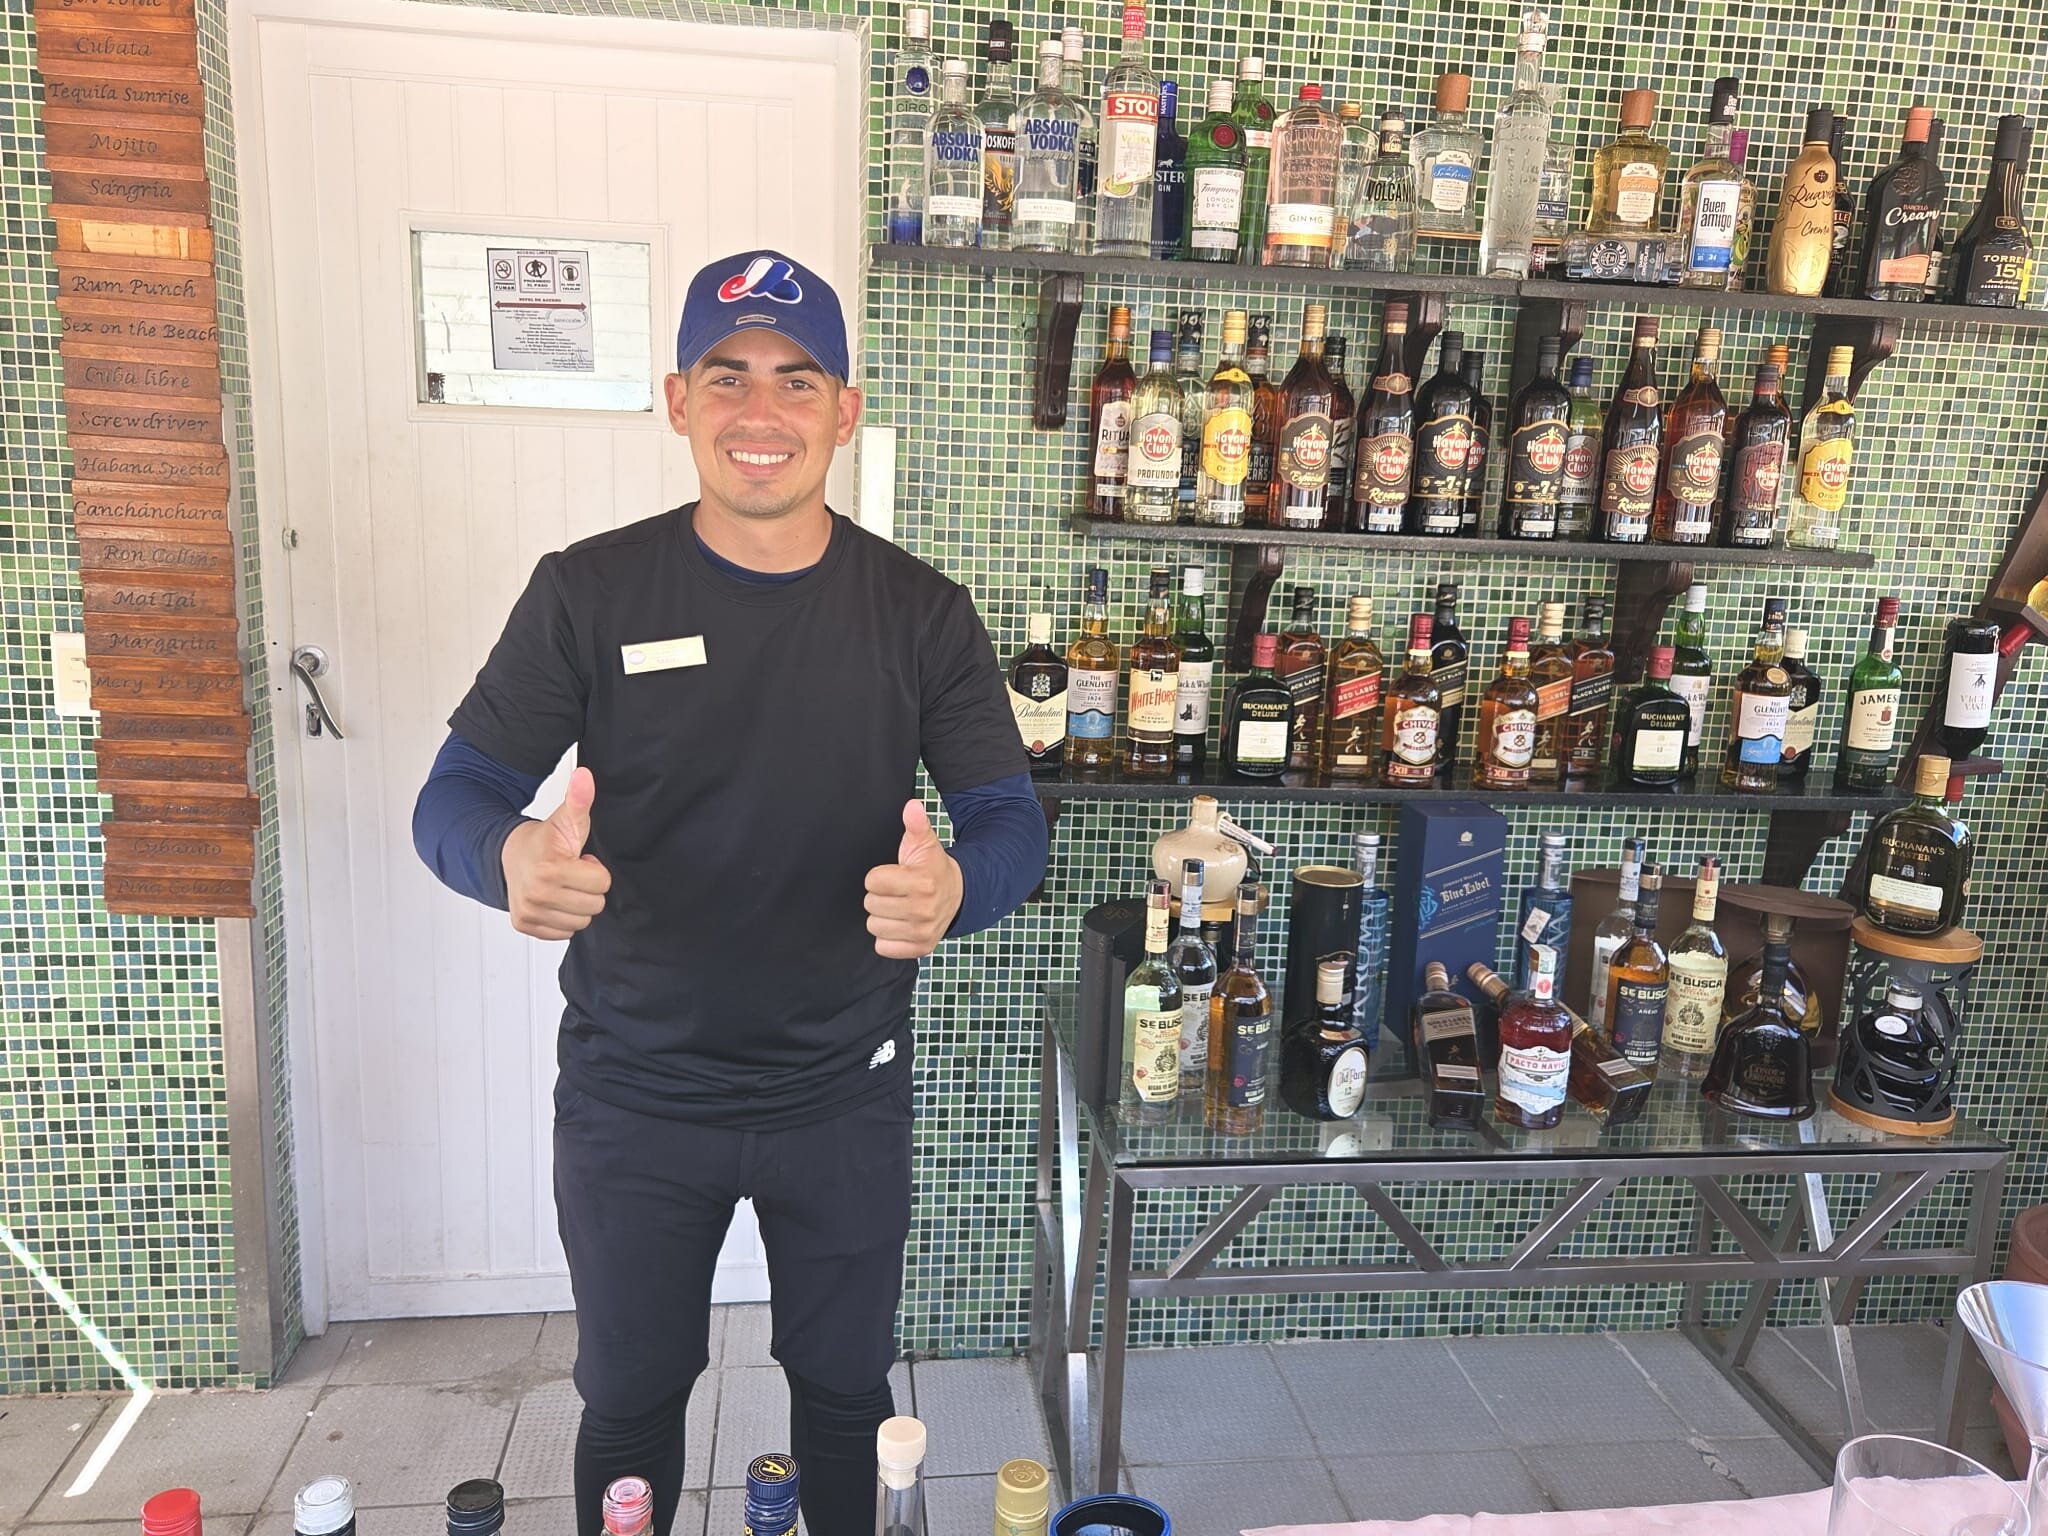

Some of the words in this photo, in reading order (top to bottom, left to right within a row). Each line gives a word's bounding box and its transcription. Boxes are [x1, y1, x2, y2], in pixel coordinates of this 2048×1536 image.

[76, 36, 153, 56] Cubata
[49, 83, 118, 105] Tequila
[125, 87, 190, 106] Sunrise
[1025, 119, 1079, 138] ABSOLUT
[89, 133, 158, 157] Mojito
[932, 132, 983, 148] ABSOLUT
[985, 134, 1016, 150] OSKOFF
[1030, 134, 1075, 152] VODKA
[937, 146, 979, 163] VODKA
[1155, 170, 1186, 184] STER
[1702, 197, 1726, 213] Buen
[1289, 214, 1308, 223] GIN
[1309, 215, 1324, 224] MG
[1700, 212, 1732, 233] amigo
[1885, 206, 1941, 227] Cream
[1994, 263, 2017, 279] 15
[72, 276, 124, 293] Rum
[130, 279, 197, 298] Punch
[62, 317, 93, 333] Sex
[100, 322, 122, 335] on
[129, 321, 157, 338] the
[163, 324, 219, 343] Beach
[85, 366, 138, 386] Cuba
[1139, 432, 1177, 444] Havana
[1214, 431, 1250, 445] Havana
[1293, 436, 1329, 450] Havana
[1432, 434, 1470, 449] Havana
[1146, 442, 1169, 454] Club
[1221, 443, 1243, 456] Club
[1299, 448, 1322, 461] Club
[1441, 447, 1465, 461] Club
[1469, 446, 1486, 456] ana
[1248, 456, 1269, 468] LACK
[1535, 452, 1560, 466] Club
[80, 457, 154, 474] Habana
[158, 461, 224, 479] Special
[1137, 469, 1175, 480] PROFUNDO
[1247, 468, 1268, 481] EARS
[1379, 463, 1401, 477] Club
[1566, 462, 1589, 473] Club
[1692, 464, 1715, 478] Club
[1629, 473, 1651, 486] Club
[1823, 471, 1844, 484] Club
[104, 545, 146, 562] Ron
[112, 591, 157, 608] Mai
[161, 591, 197, 608] Tai
[109, 633, 218, 656] Margarita
[1076, 679, 1112, 688] GLENLIVET
[1290, 681, 1304, 691] ACK
[1354, 683, 1379, 697] LABEL
[1131, 691, 1155, 714] WHITE
[1242, 702, 1289, 711] BUCHANAN'S
[1641, 712, 1686, 721] BUCHANAN'S
[1881, 836, 1946, 856] BUCHANAN'S
[1440, 889, 1464, 905] Blue
[1463, 877, 1492, 897] Label
[1683, 976, 1722, 989] BUSCA
[1510, 1057, 1539, 1070] PACTO
[1335, 1071, 1349, 1087] Old
